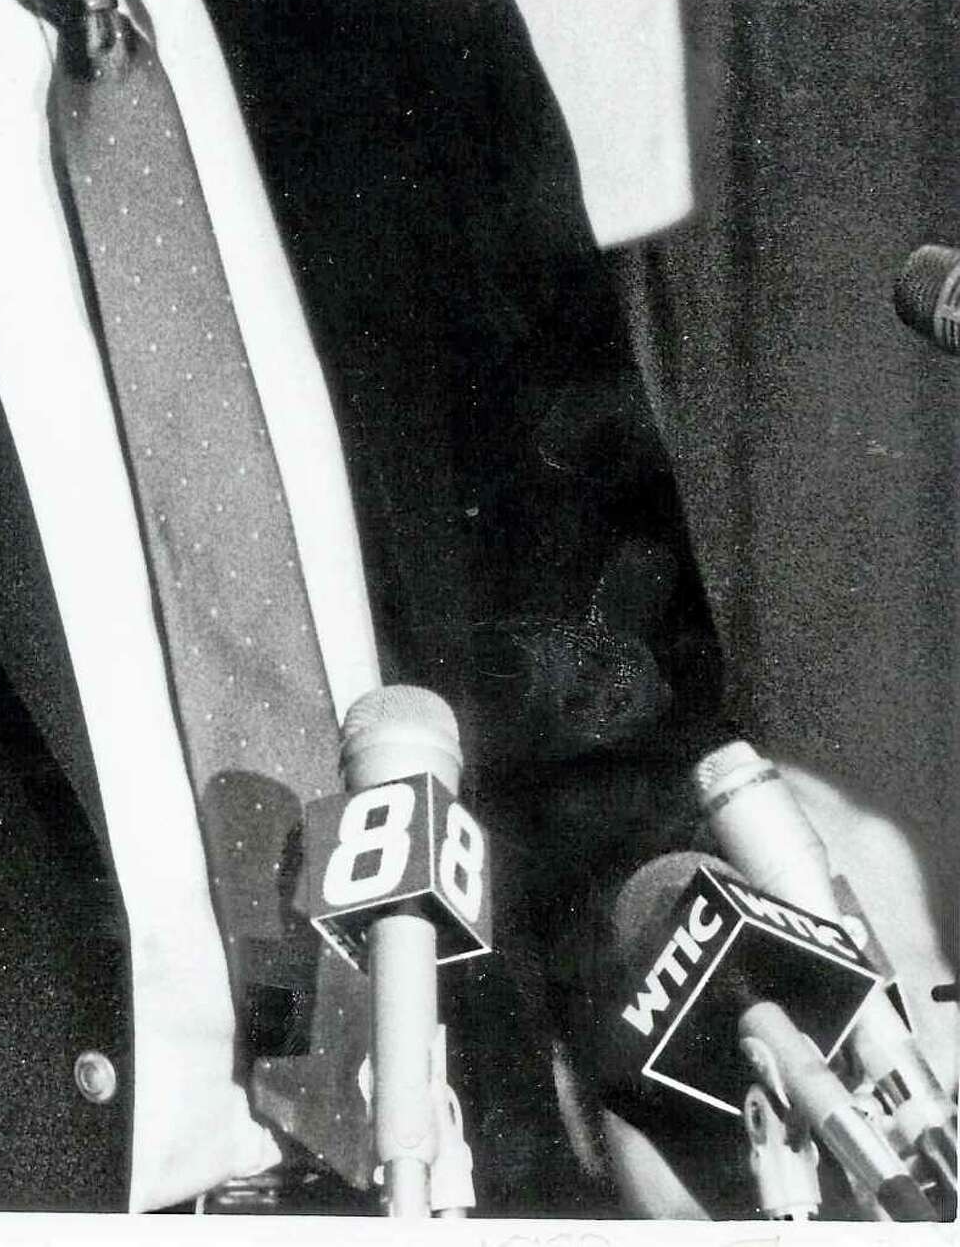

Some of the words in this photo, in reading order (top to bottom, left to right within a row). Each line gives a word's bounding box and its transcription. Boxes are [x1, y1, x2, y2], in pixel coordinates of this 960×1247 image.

[323, 782, 416, 907] 8
[439, 801, 485, 924] 8
[621, 893, 724, 1037] WTIC
[728, 882, 859, 960] WTIC
